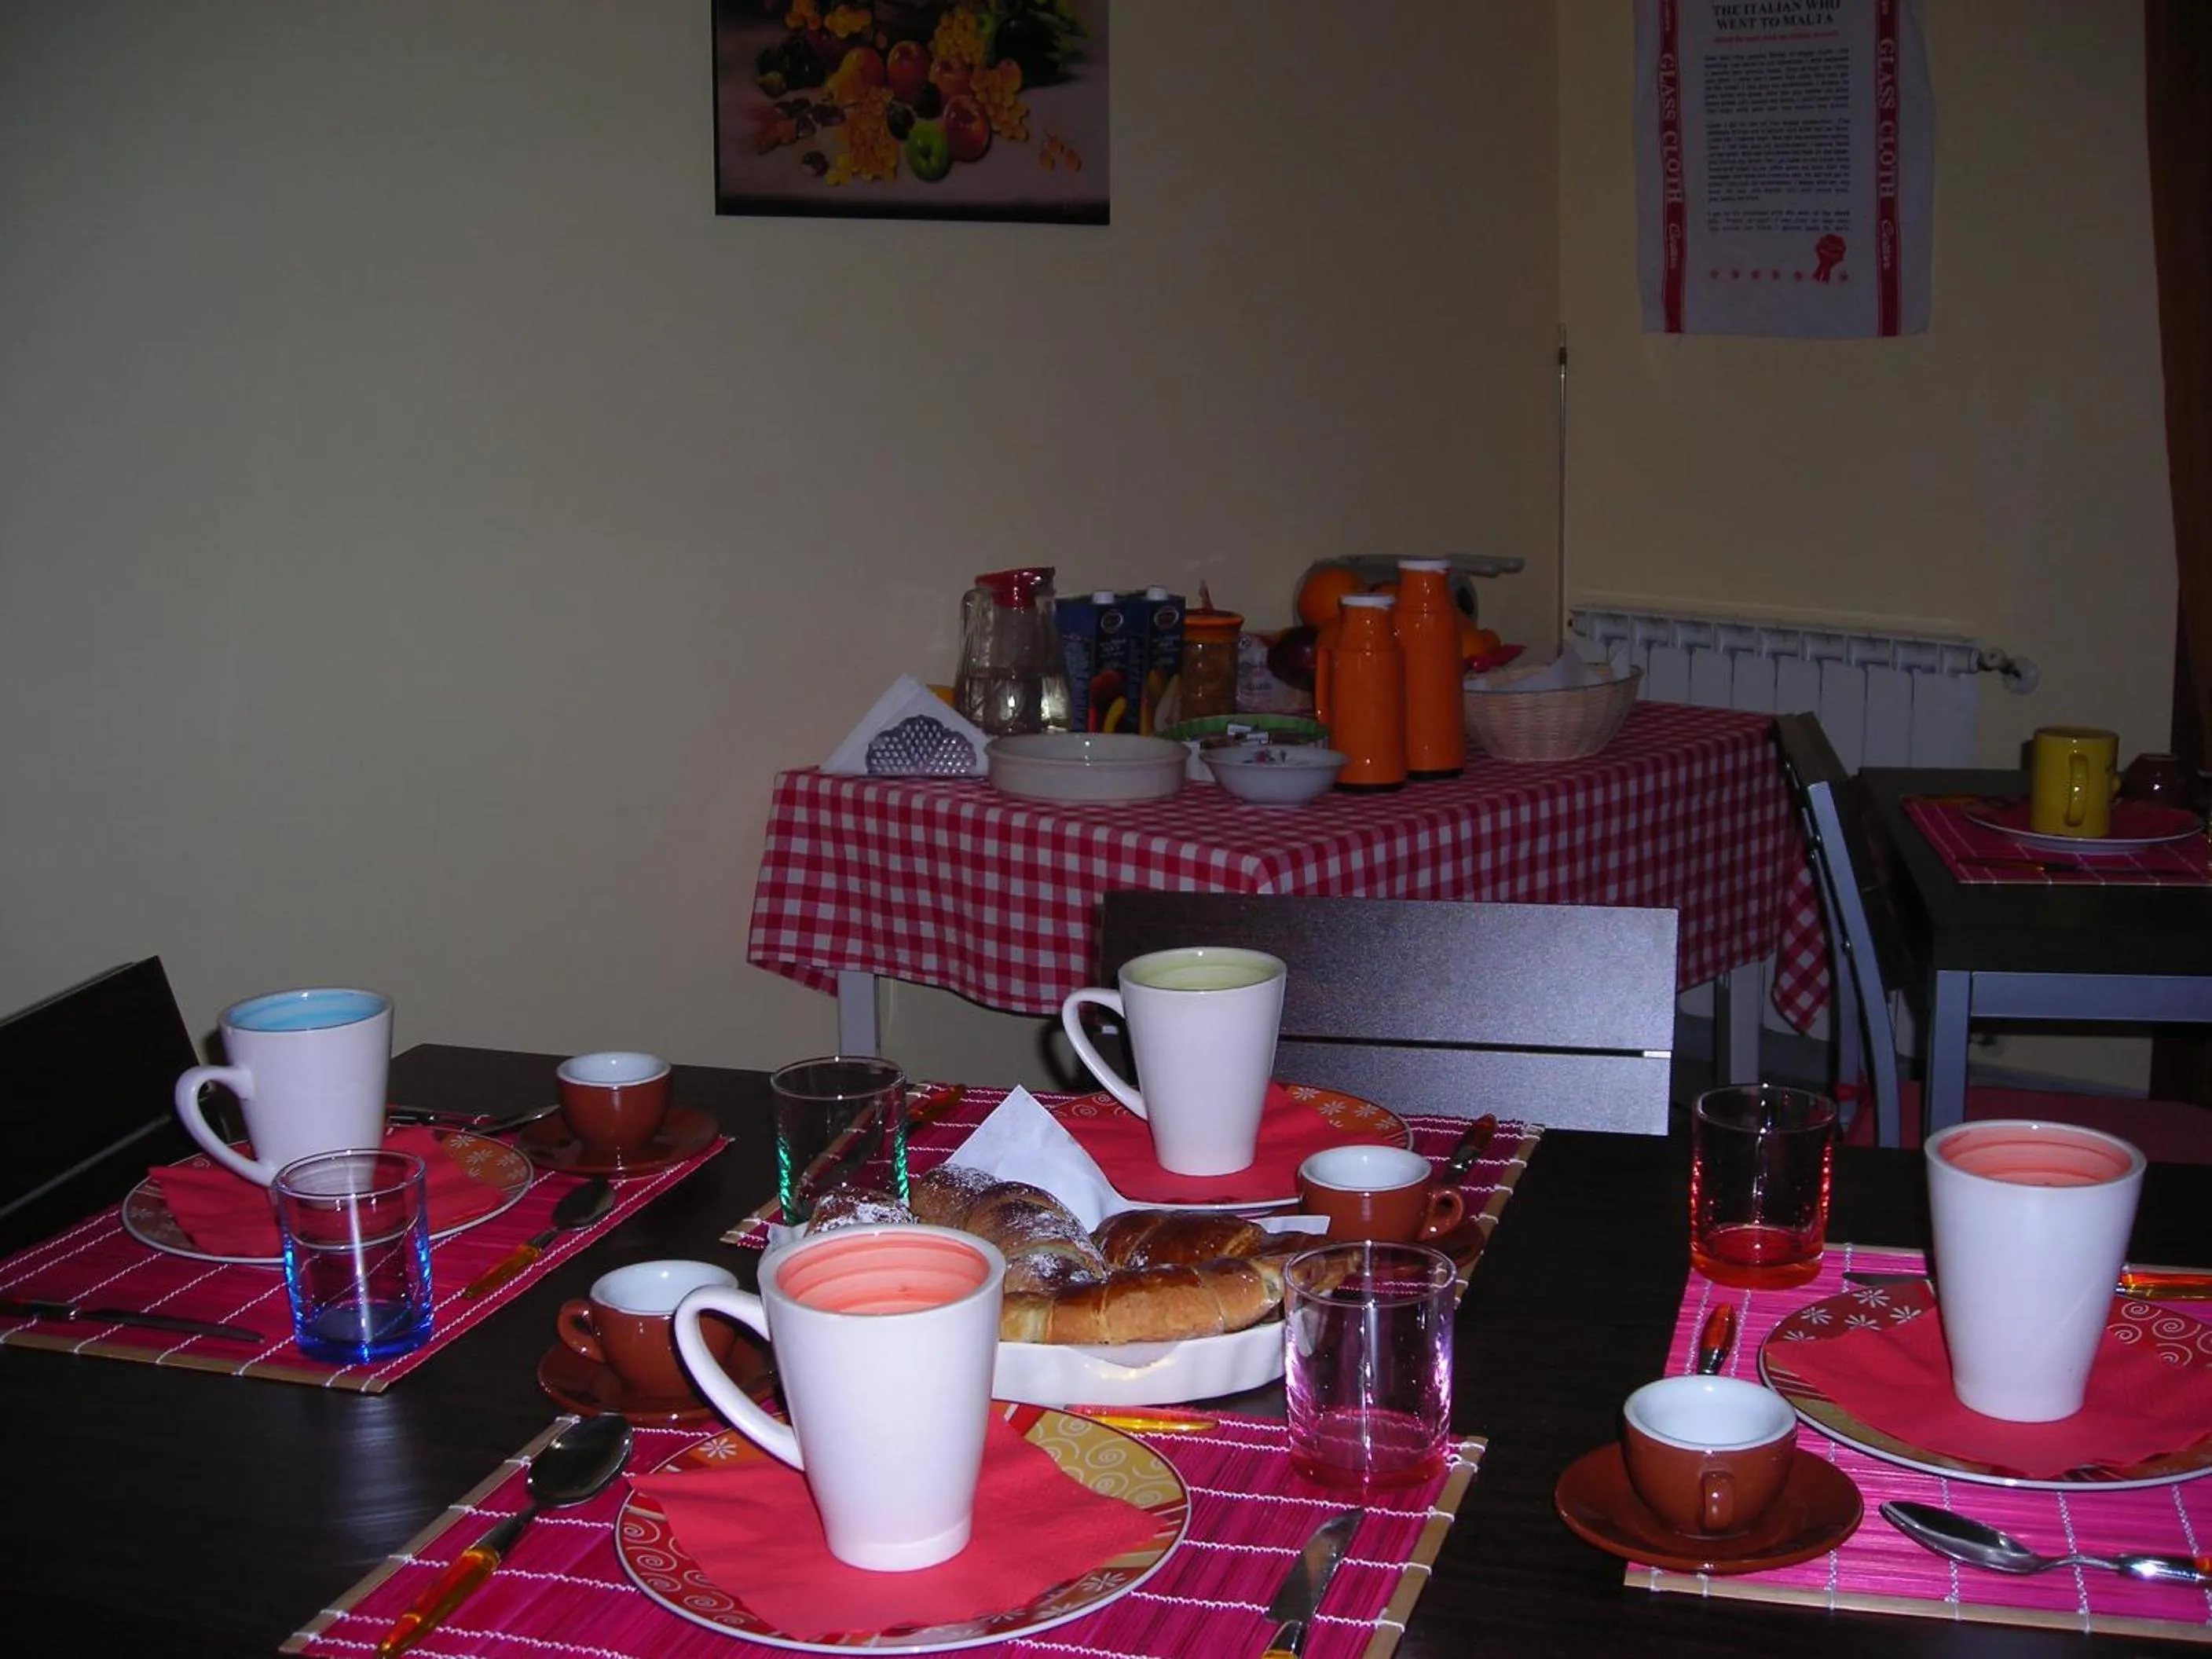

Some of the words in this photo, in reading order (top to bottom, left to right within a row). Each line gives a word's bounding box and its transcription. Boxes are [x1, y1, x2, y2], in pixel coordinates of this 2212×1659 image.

[1712, 5, 1738, 16] THE
[1744, 2, 1800, 14] ITALIAN
[1806, 0, 1840, 10] WHO
[1716, 17, 1756, 30] WENT
[1760, 16, 1780, 27] TO
[1783, 13, 1833, 25] MALTA
[1658, 53, 1677, 122] GLASS
[1878, 38, 1896, 109] GLASS
[1662, 130, 1682, 204] CLOTH
[1879, 120, 1896, 198] CLOTH
